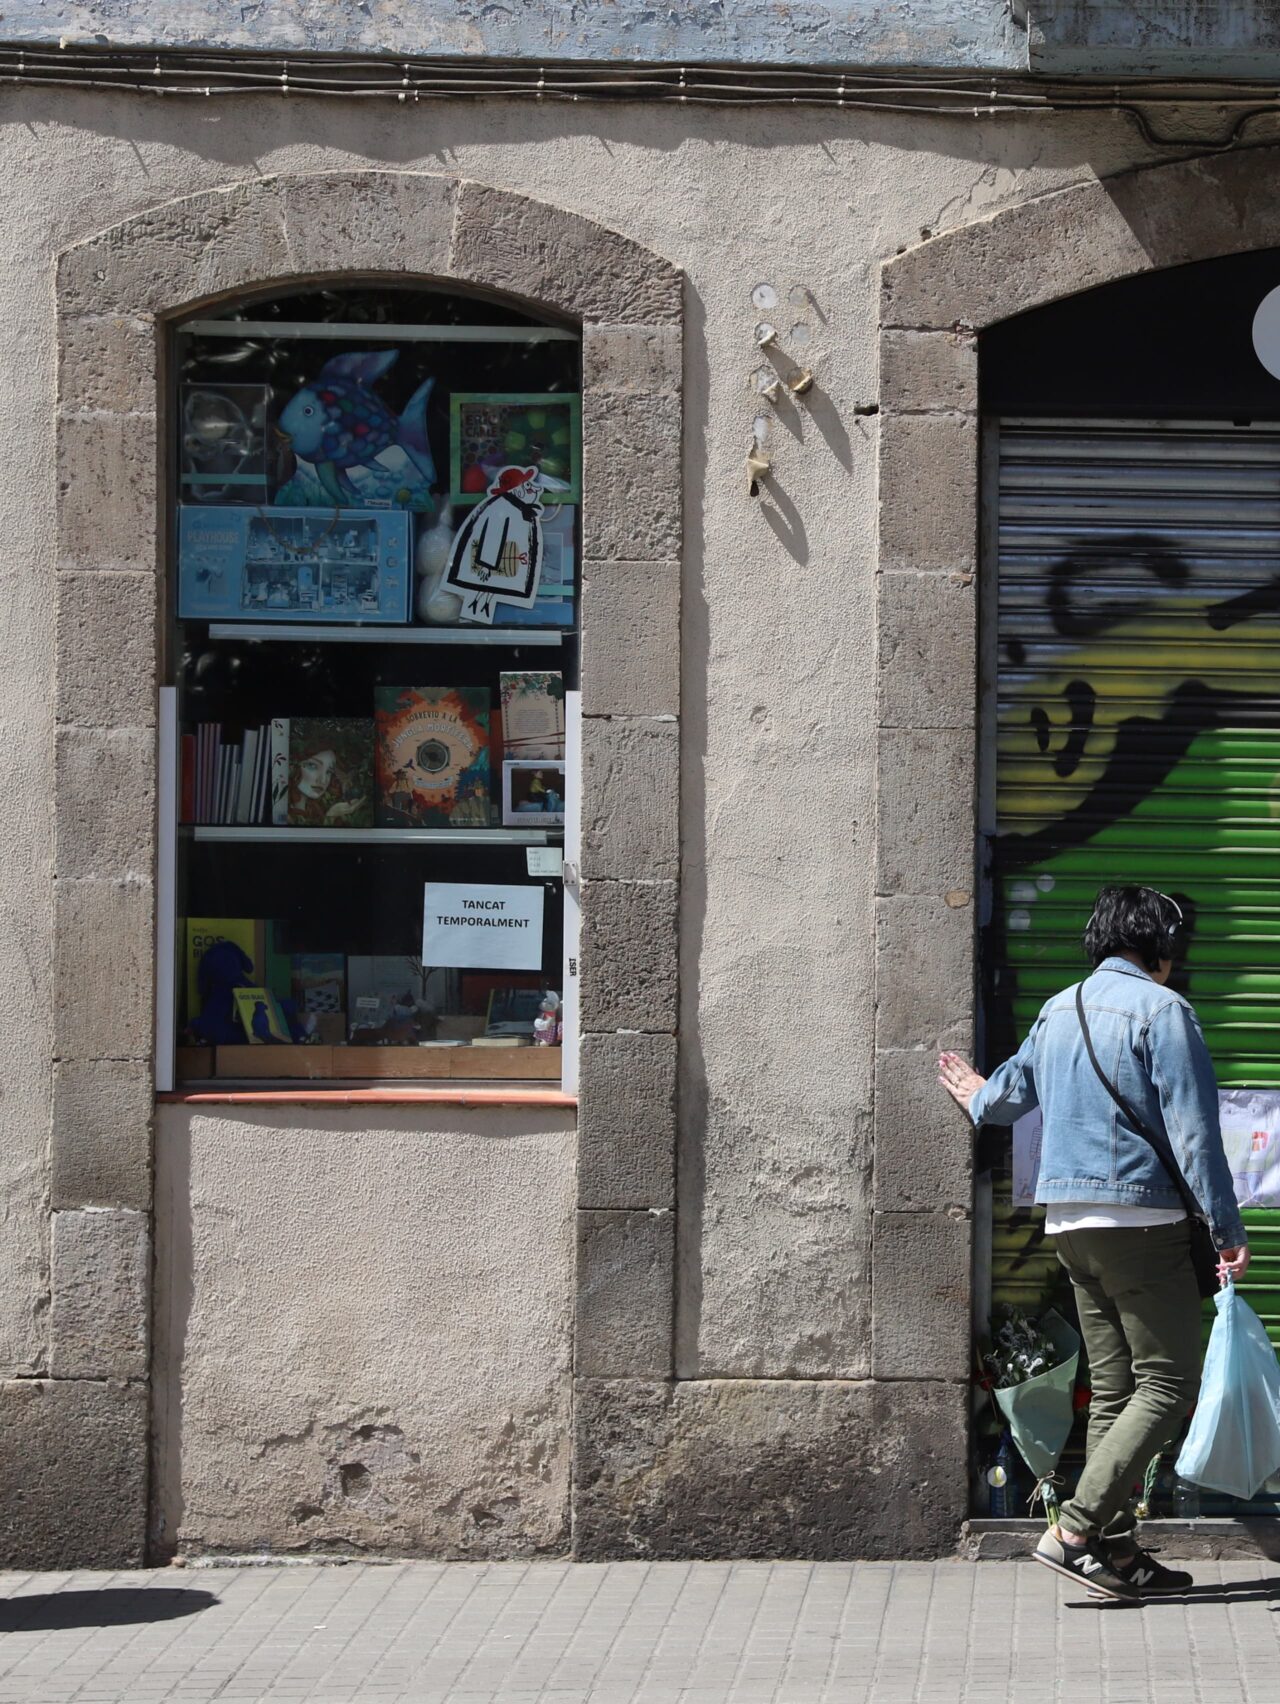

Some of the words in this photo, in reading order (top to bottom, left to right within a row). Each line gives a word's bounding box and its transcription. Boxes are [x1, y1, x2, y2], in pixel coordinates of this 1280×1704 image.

[464, 415, 498, 426] ERIC
[187, 529, 240, 544] PLAYHOUSE
[462, 899, 506, 911] TANCAT
[437, 916, 530, 929] TEMPORALMENT
[569, 957, 577, 977] ISER
[1072, 1553, 1103, 1575] N
[1129, 1567, 1155, 1587] N
